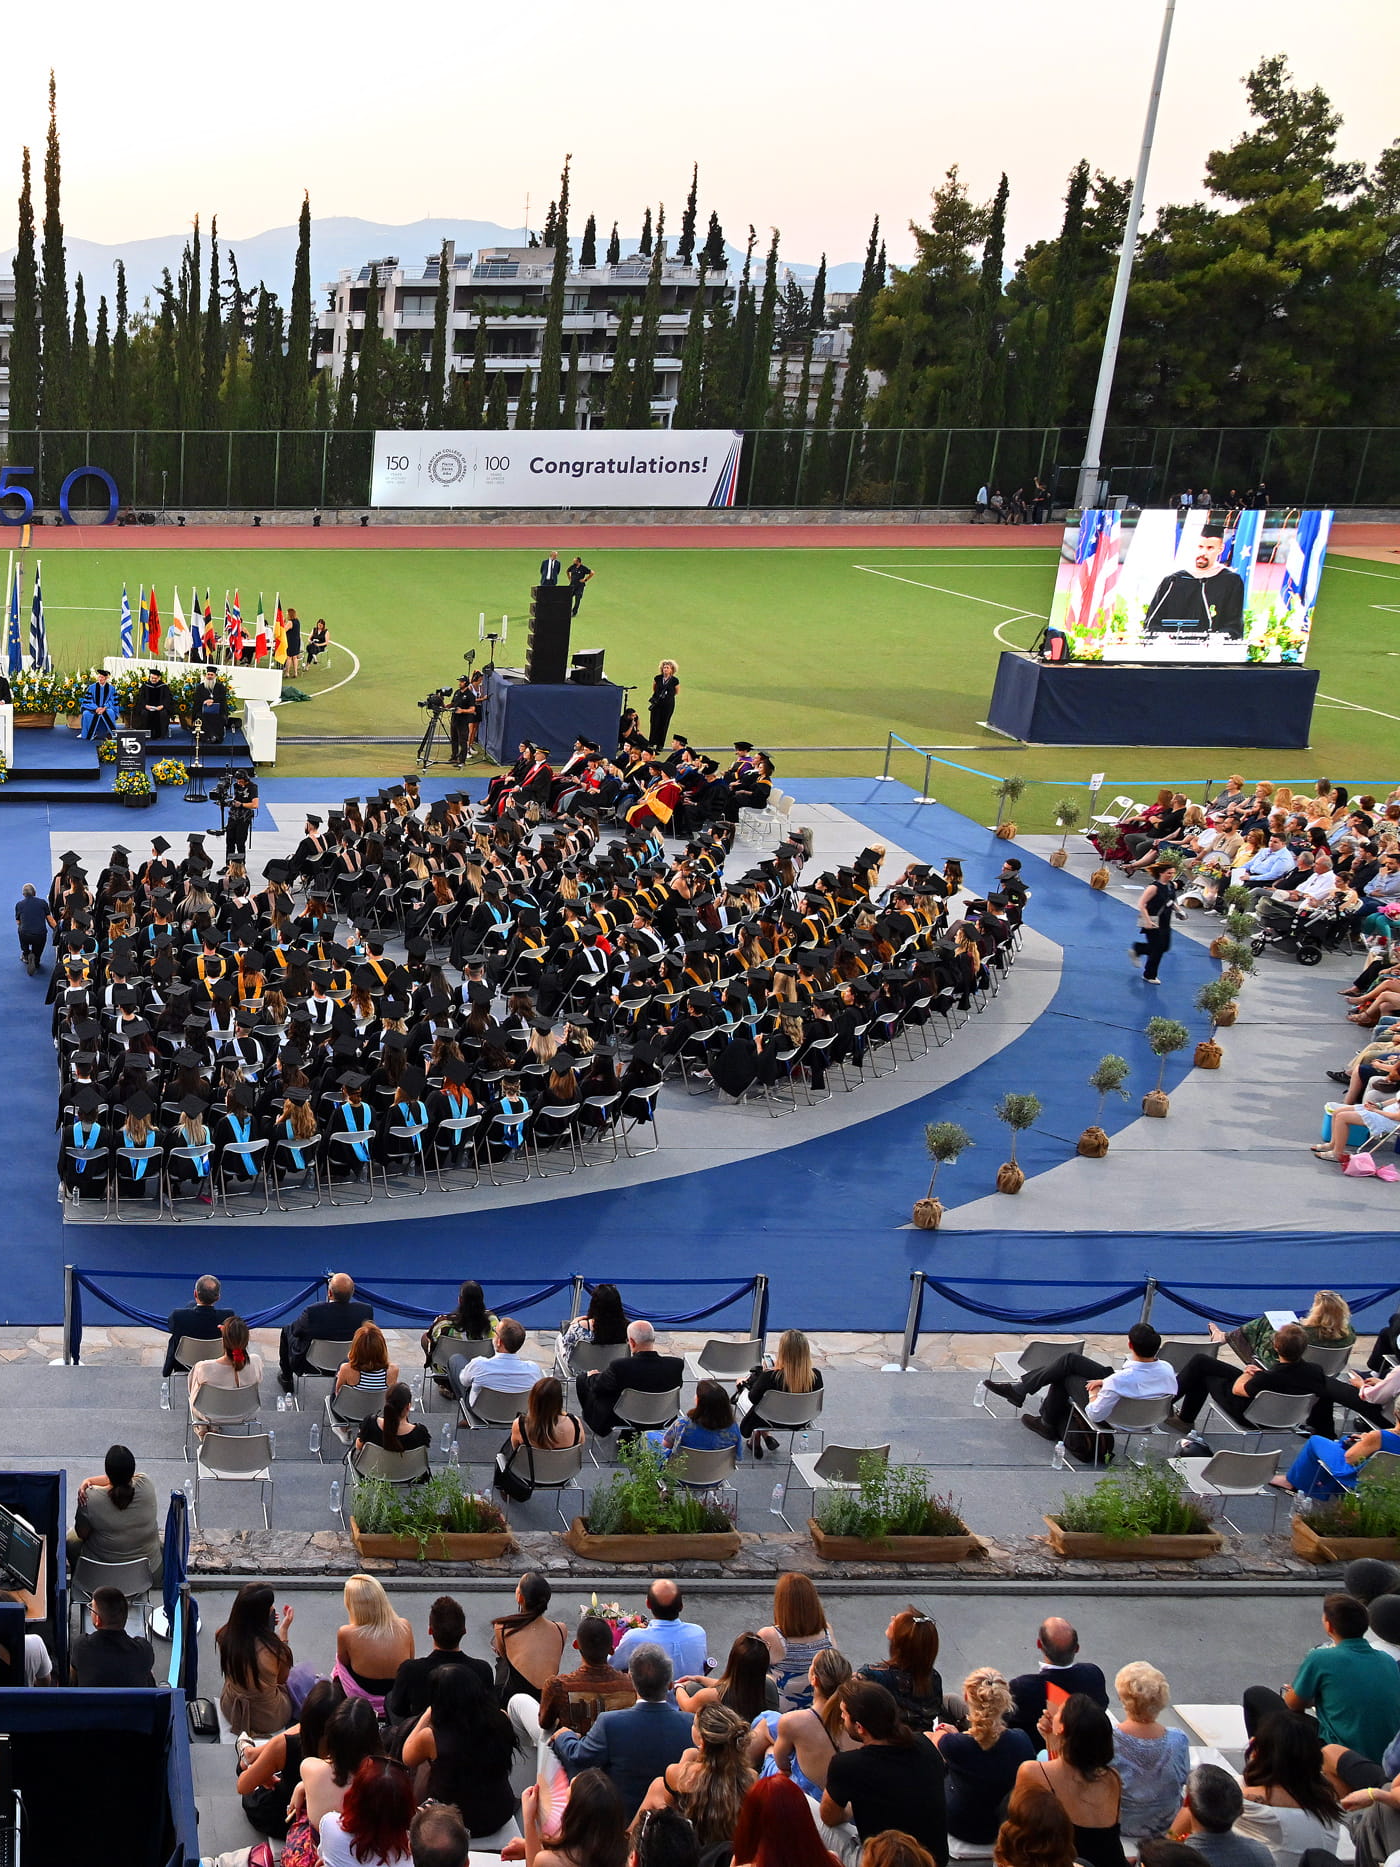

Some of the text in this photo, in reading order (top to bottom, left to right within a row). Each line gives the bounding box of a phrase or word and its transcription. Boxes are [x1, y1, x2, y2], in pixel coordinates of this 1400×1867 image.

[386, 455, 410, 471] 150
[484, 455, 510, 471] 100
[529, 456, 709, 478] Congratulations!
